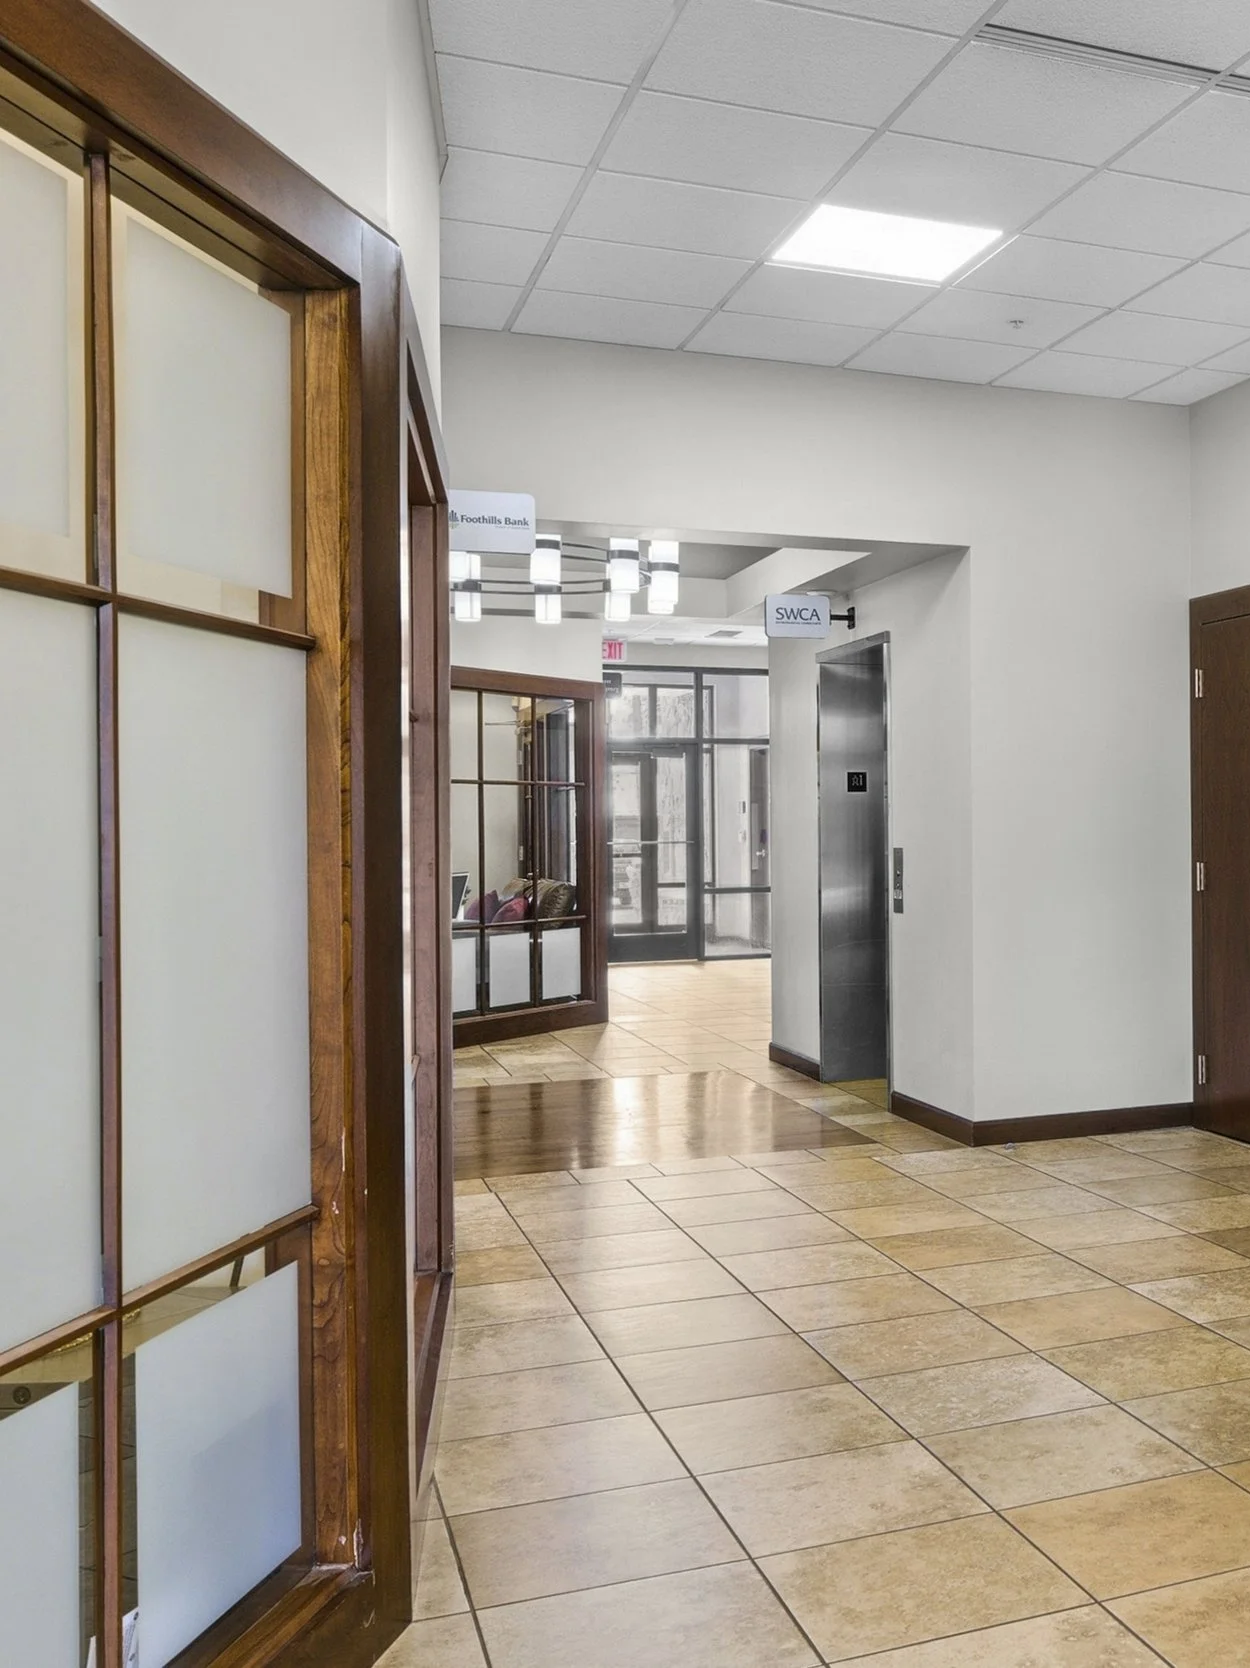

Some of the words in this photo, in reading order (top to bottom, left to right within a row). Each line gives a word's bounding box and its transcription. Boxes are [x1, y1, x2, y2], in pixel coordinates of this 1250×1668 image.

[460, 514, 502, 525] Foothills
[504, 517, 530, 526] Bank
[775, 607, 821, 621] SWCA
